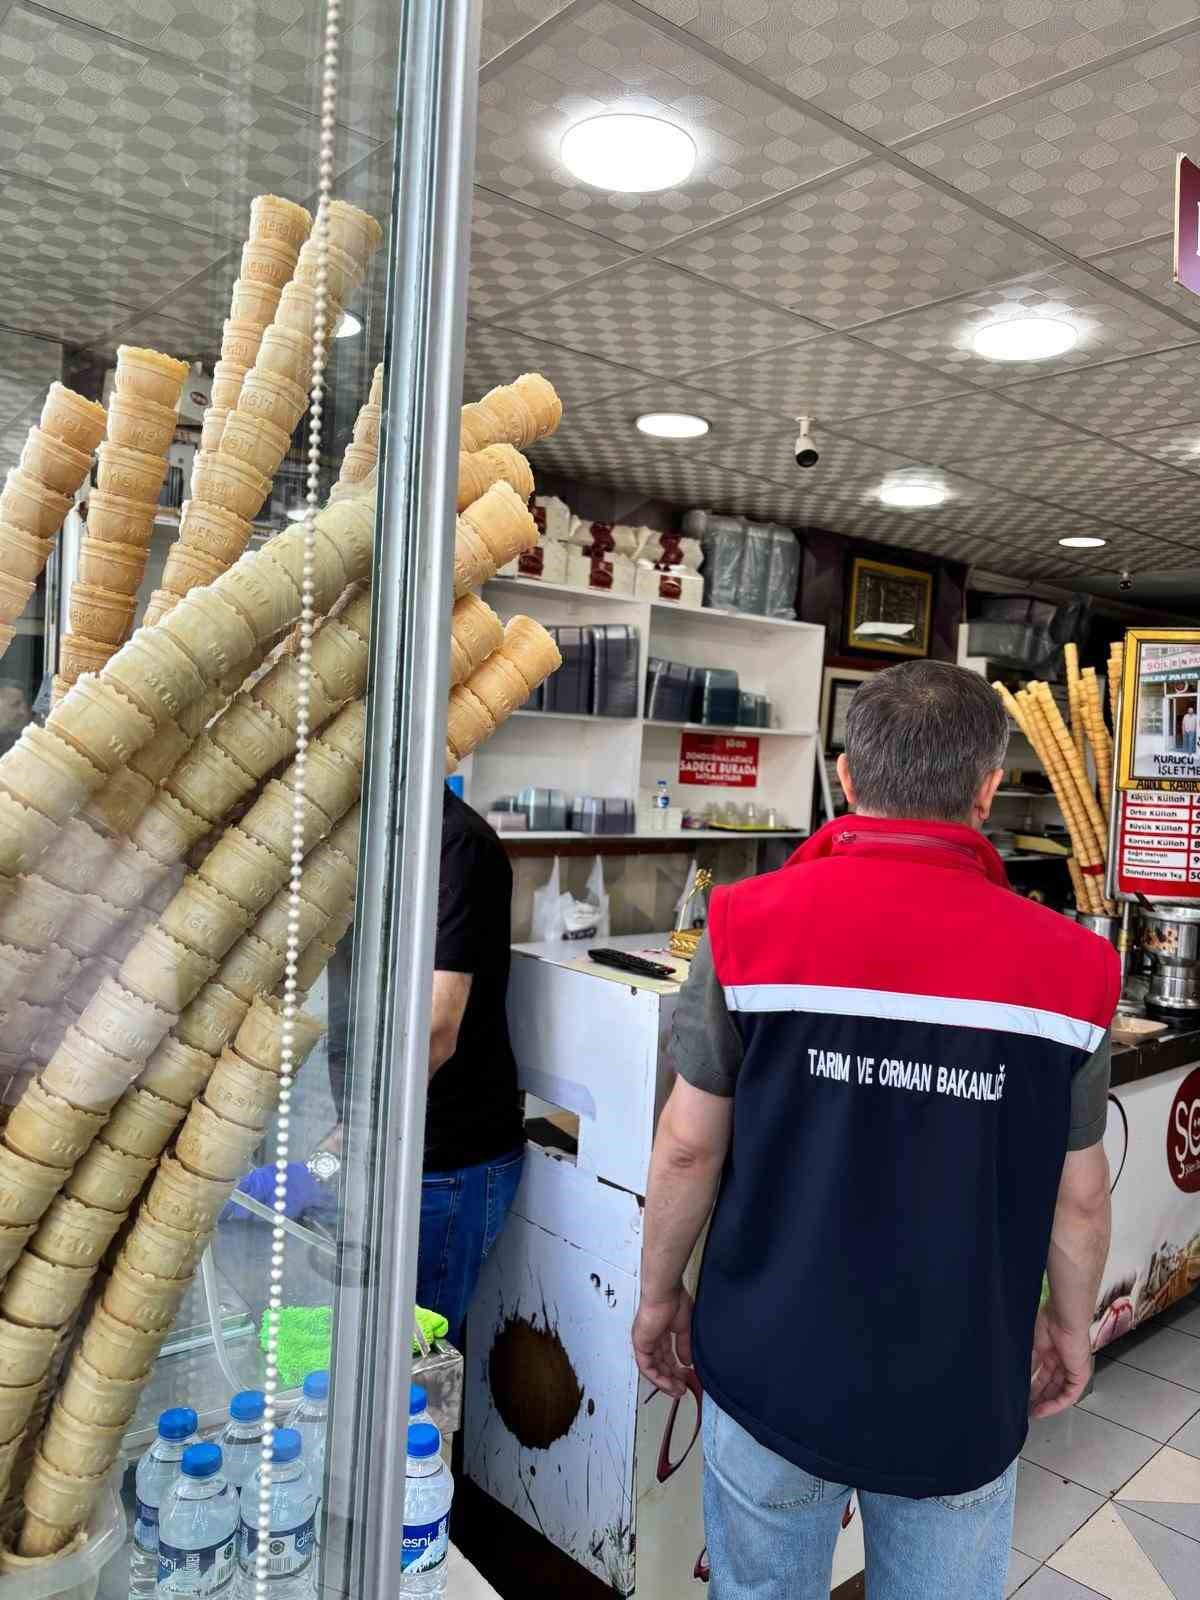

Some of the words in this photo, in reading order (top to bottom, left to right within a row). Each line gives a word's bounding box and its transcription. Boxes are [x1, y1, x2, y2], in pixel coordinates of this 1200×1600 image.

[1153, 754, 1194, 765] KURUCU
[679, 760, 717, 773] SADECE
[808, 1048, 850, 1082] TARIM
[857, 1056, 874, 1085] VE
[879, 1058, 932, 1092] ORMAN
